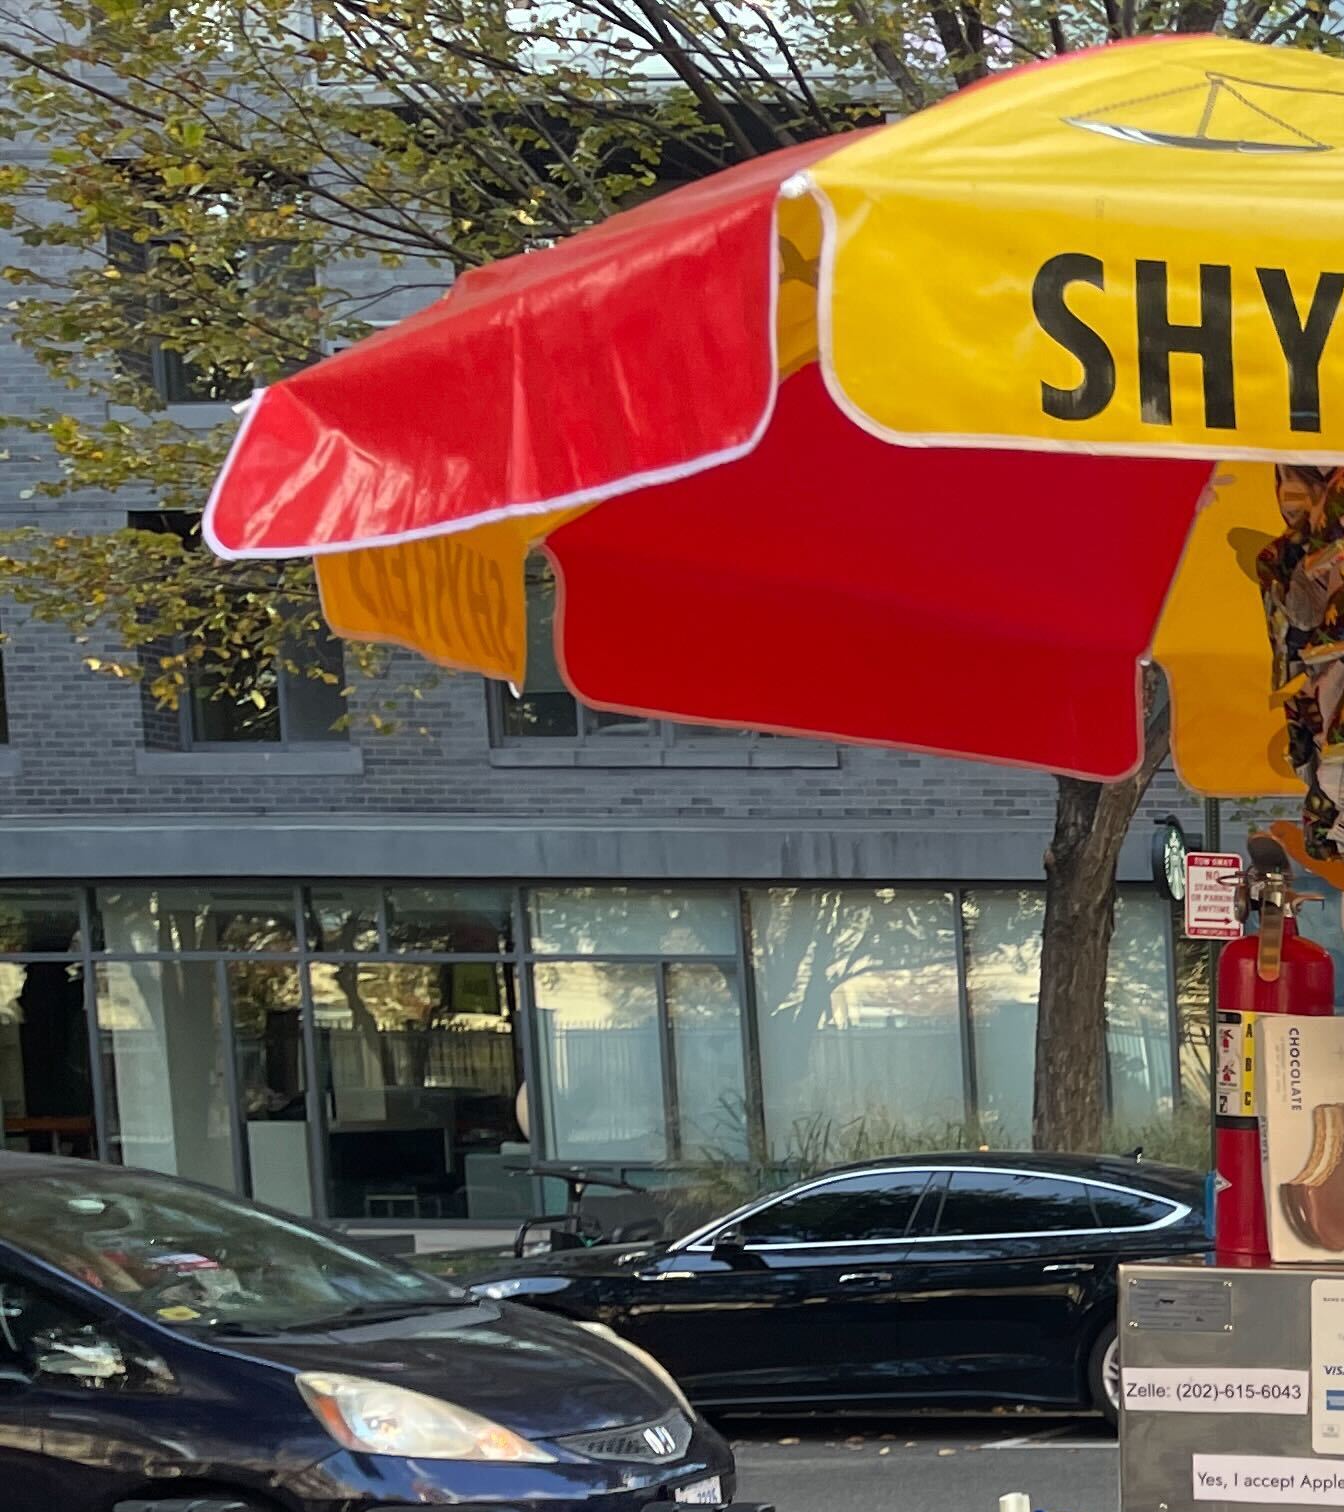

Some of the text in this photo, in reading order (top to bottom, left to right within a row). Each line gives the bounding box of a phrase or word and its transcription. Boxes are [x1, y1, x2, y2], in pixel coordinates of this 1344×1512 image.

[1205, 870, 1220, 881] NO
[1204, 894, 1233, 902] PARKIN
[1288, 1027, 1302, 1111] CHOCOLATE
[1126, 1382, 1302, 1402] Zelle: (202)-615-6043
[1197, 1472, 1228, 1489] Yes,
[1233, 1473, 1238, 1486] I
[1243, 1474, 1296, 1492] accept
